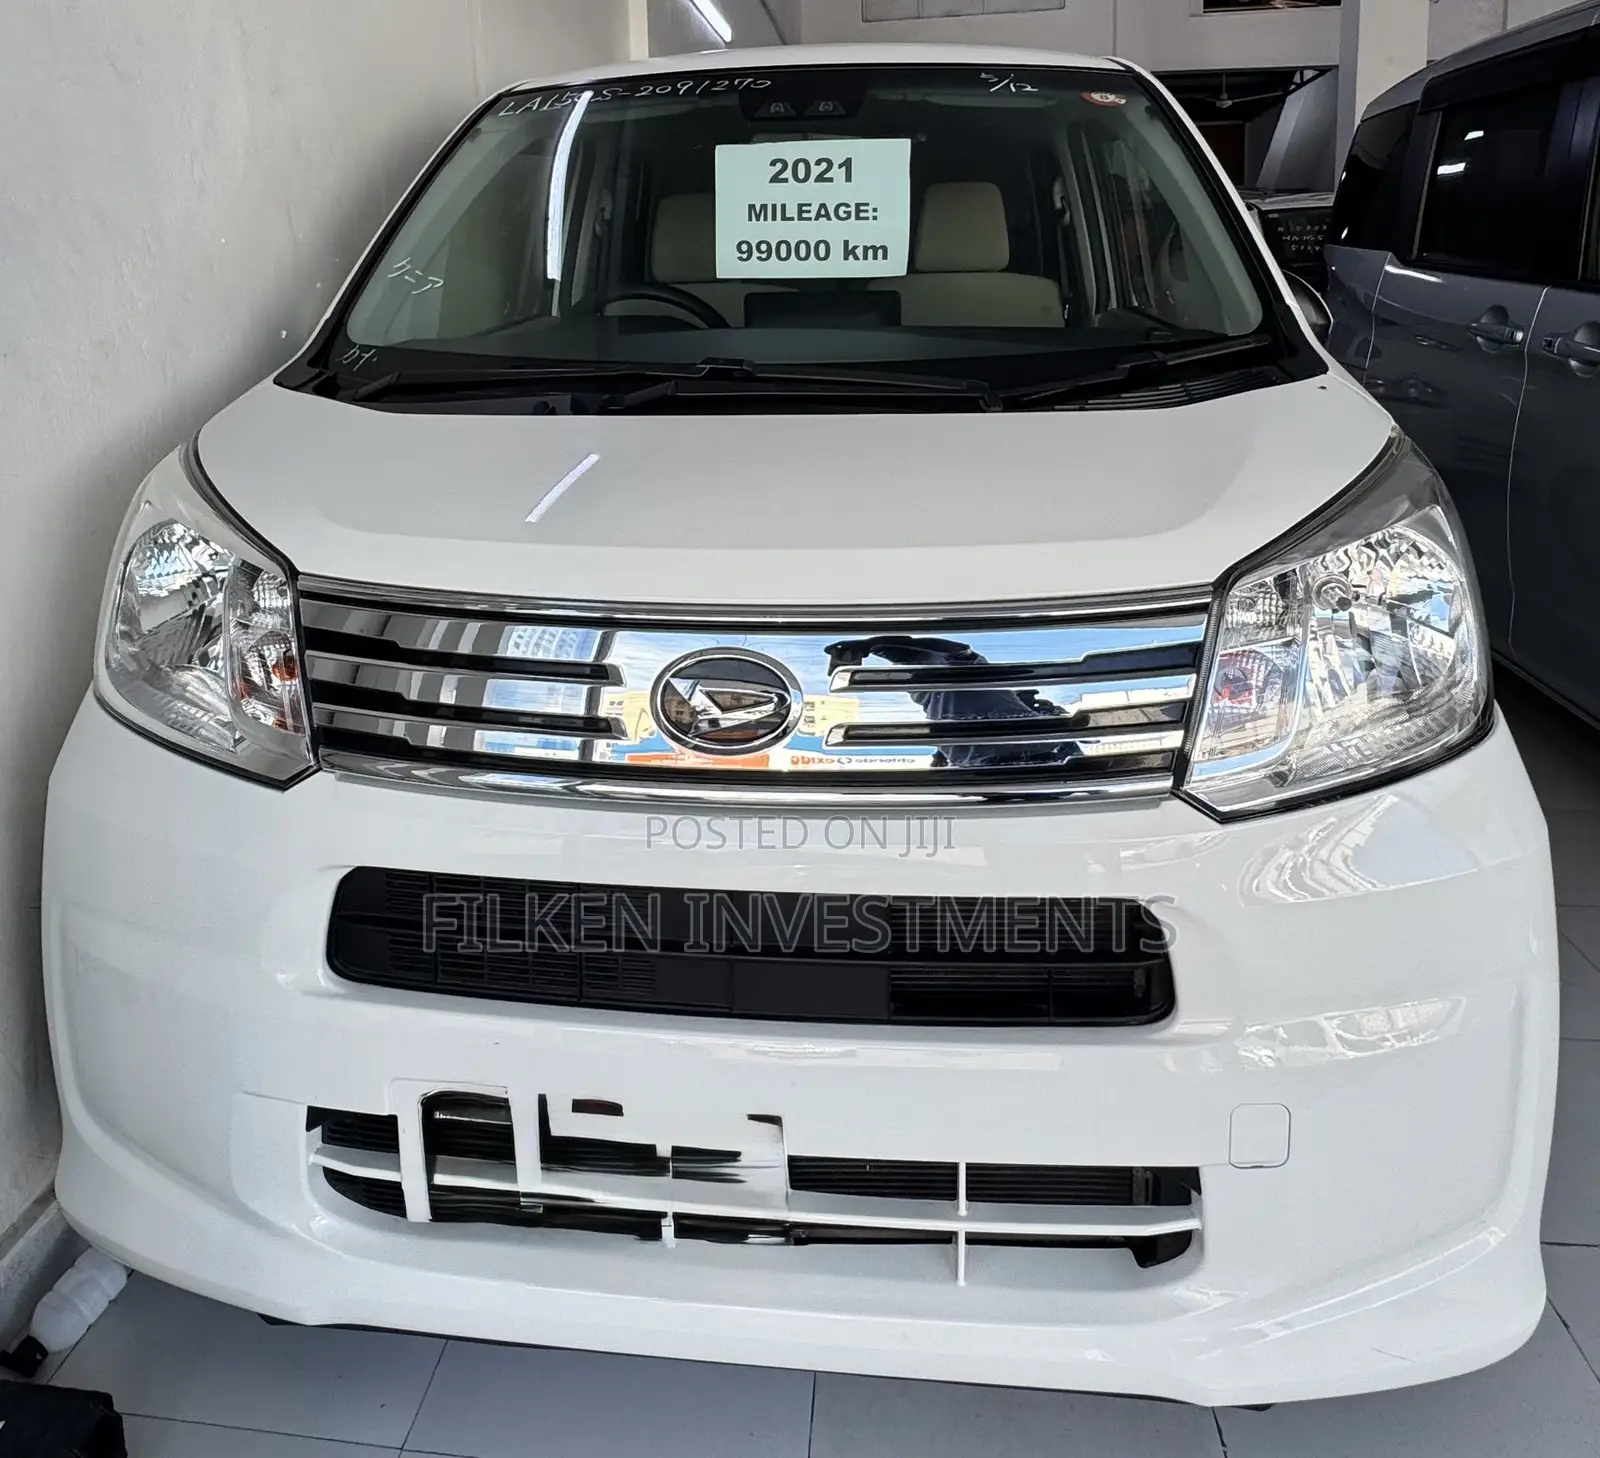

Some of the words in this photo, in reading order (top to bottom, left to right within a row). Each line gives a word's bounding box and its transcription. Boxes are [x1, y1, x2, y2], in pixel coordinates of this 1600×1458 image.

[767, 156, 854, 184] 2021
[746, 202, 879, 222] MILEAGE:
[735, 238, 831, 262] 99000
[842, 238, 889, 262] km
